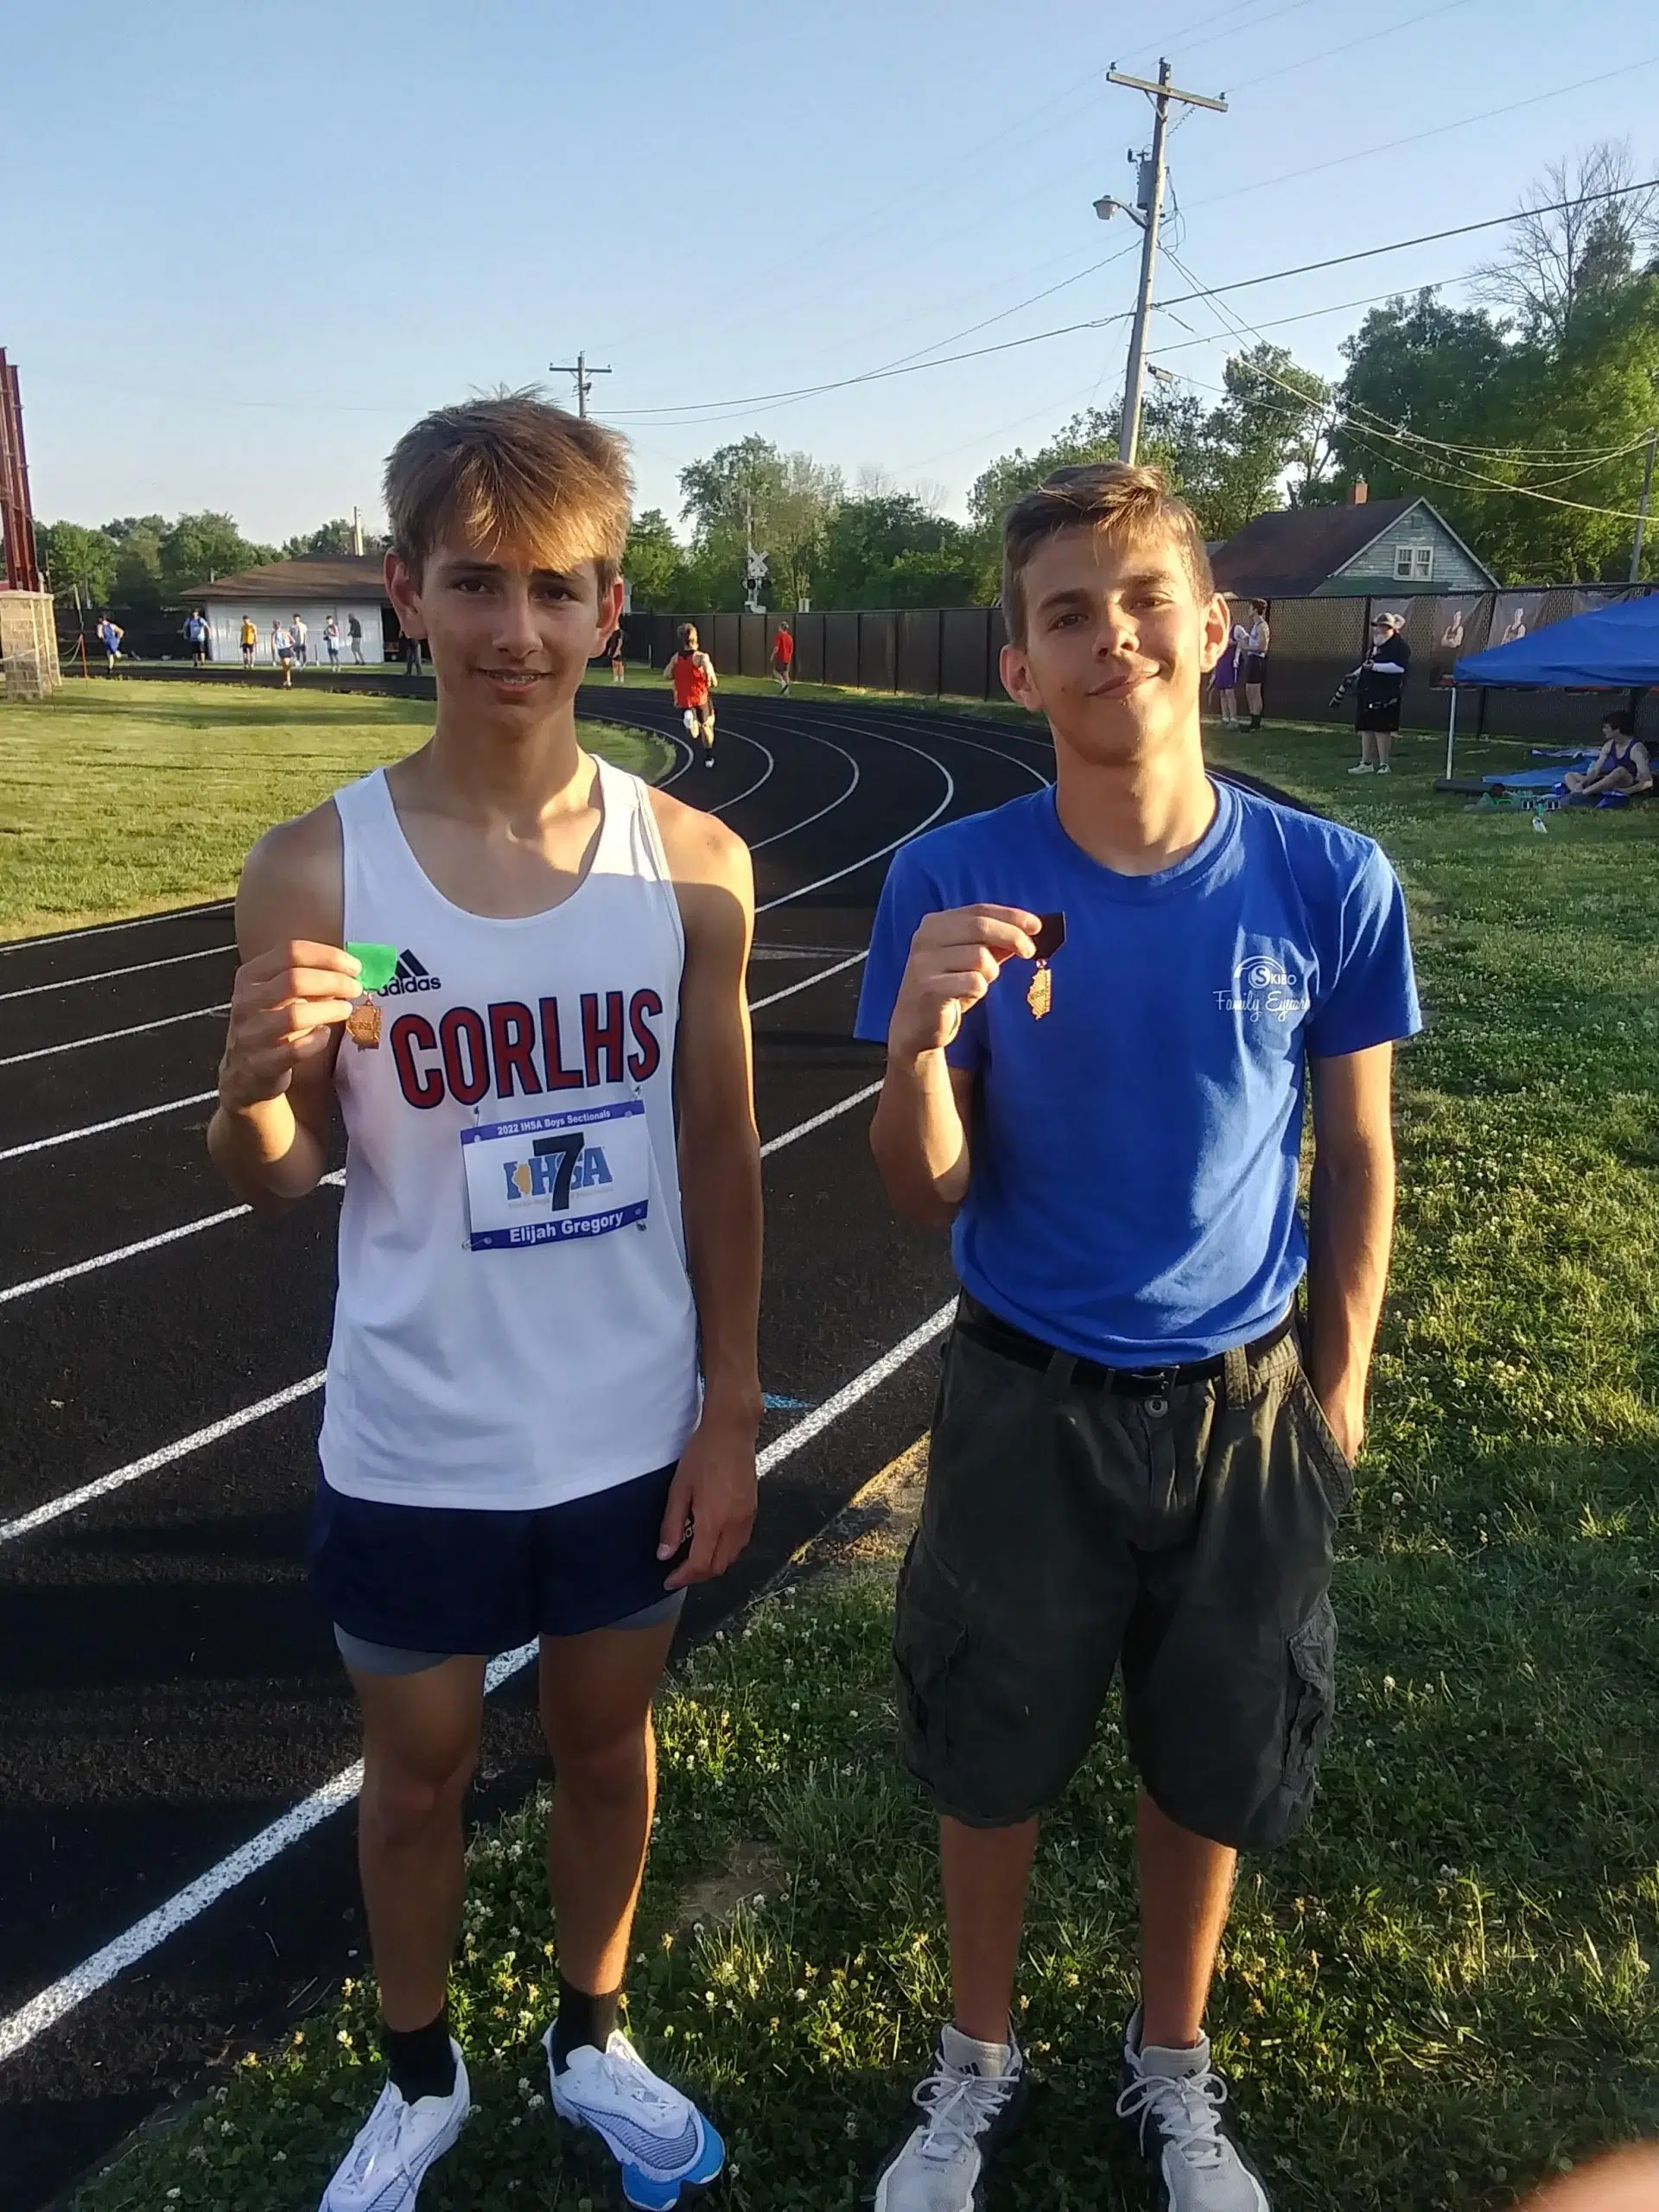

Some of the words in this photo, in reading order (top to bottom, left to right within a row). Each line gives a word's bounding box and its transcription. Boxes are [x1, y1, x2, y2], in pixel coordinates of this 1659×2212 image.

[377, 976, 442, 997] adidas
[1212, 989, 1261, 1023] Family
[390, 988, 664, 1109] CORLHS
[497, 1123, 520, 1135] 2022
[520, 1119, 543, 1133] IHSA
[543, 1116, 565, 1129] Boys
[567, 1109, 612, 1124] Sectionals
[532, 1131, 585, 1212] 7
[509, 1223, 556, 1243] Elijah
[561, 1211, 624, 1235] Gregory
